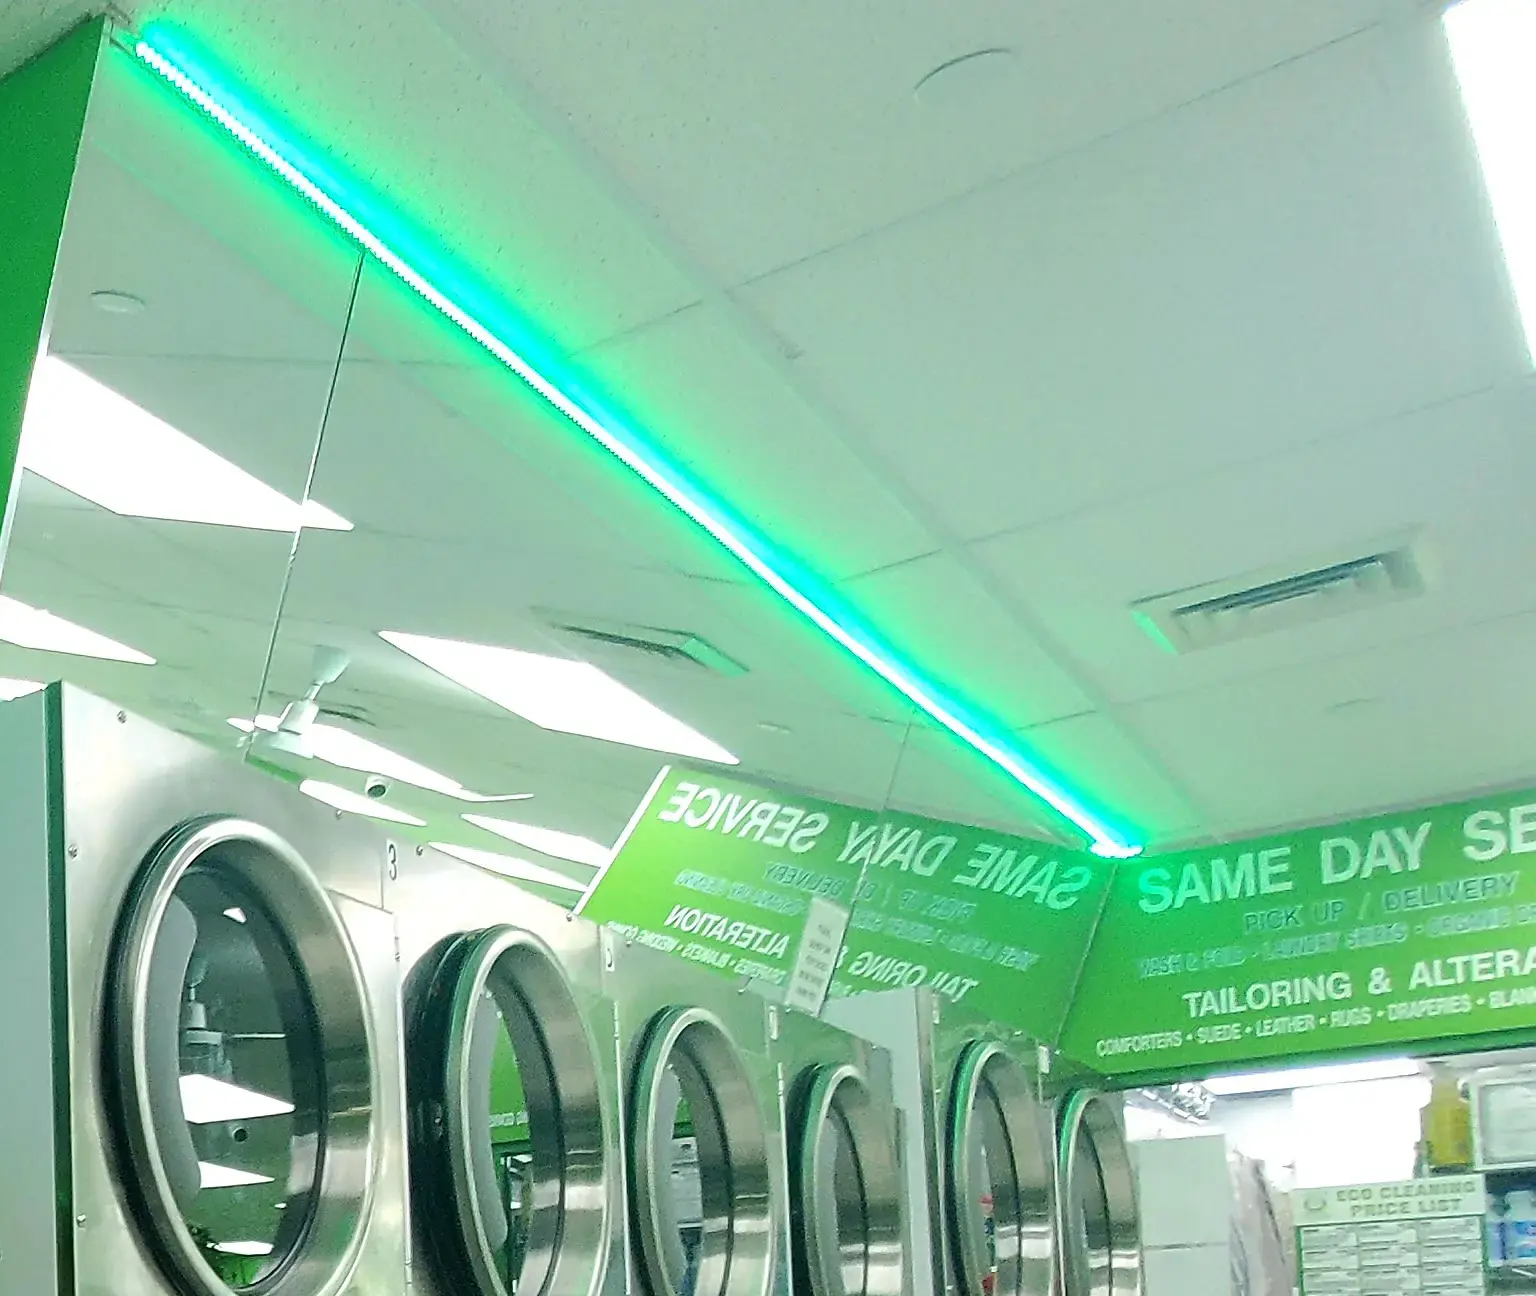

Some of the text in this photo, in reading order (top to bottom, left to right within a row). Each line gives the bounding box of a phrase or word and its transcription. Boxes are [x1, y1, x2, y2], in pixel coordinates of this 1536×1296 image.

[388, 843, 397, 881] 3
[1138, 803, 1536, 914] SAME DAY SE
[1243, 904, 1304, 934] PICK
[1312, 899, 1347, 925] UP
[1382, 871, 1521, 913] DELIVERY
[1181, 971, 1353, 1019] TAILORING
[1367, 967, 1393, 995] &
[1096, 1031, 1183, 1057] COMFORTERS
[1193, 1022, 1242, 1044] SUEDE
[1255, 1014, 1316, 1038] LEATHER
[1329, 1006, 1372, 1028] RUGS
[1387, 993, 1472, 1022] DRAPERIES
[1336, 1188, 1373, 1202] ECO
[1349, 1201, 1412, 1217] PRICE
